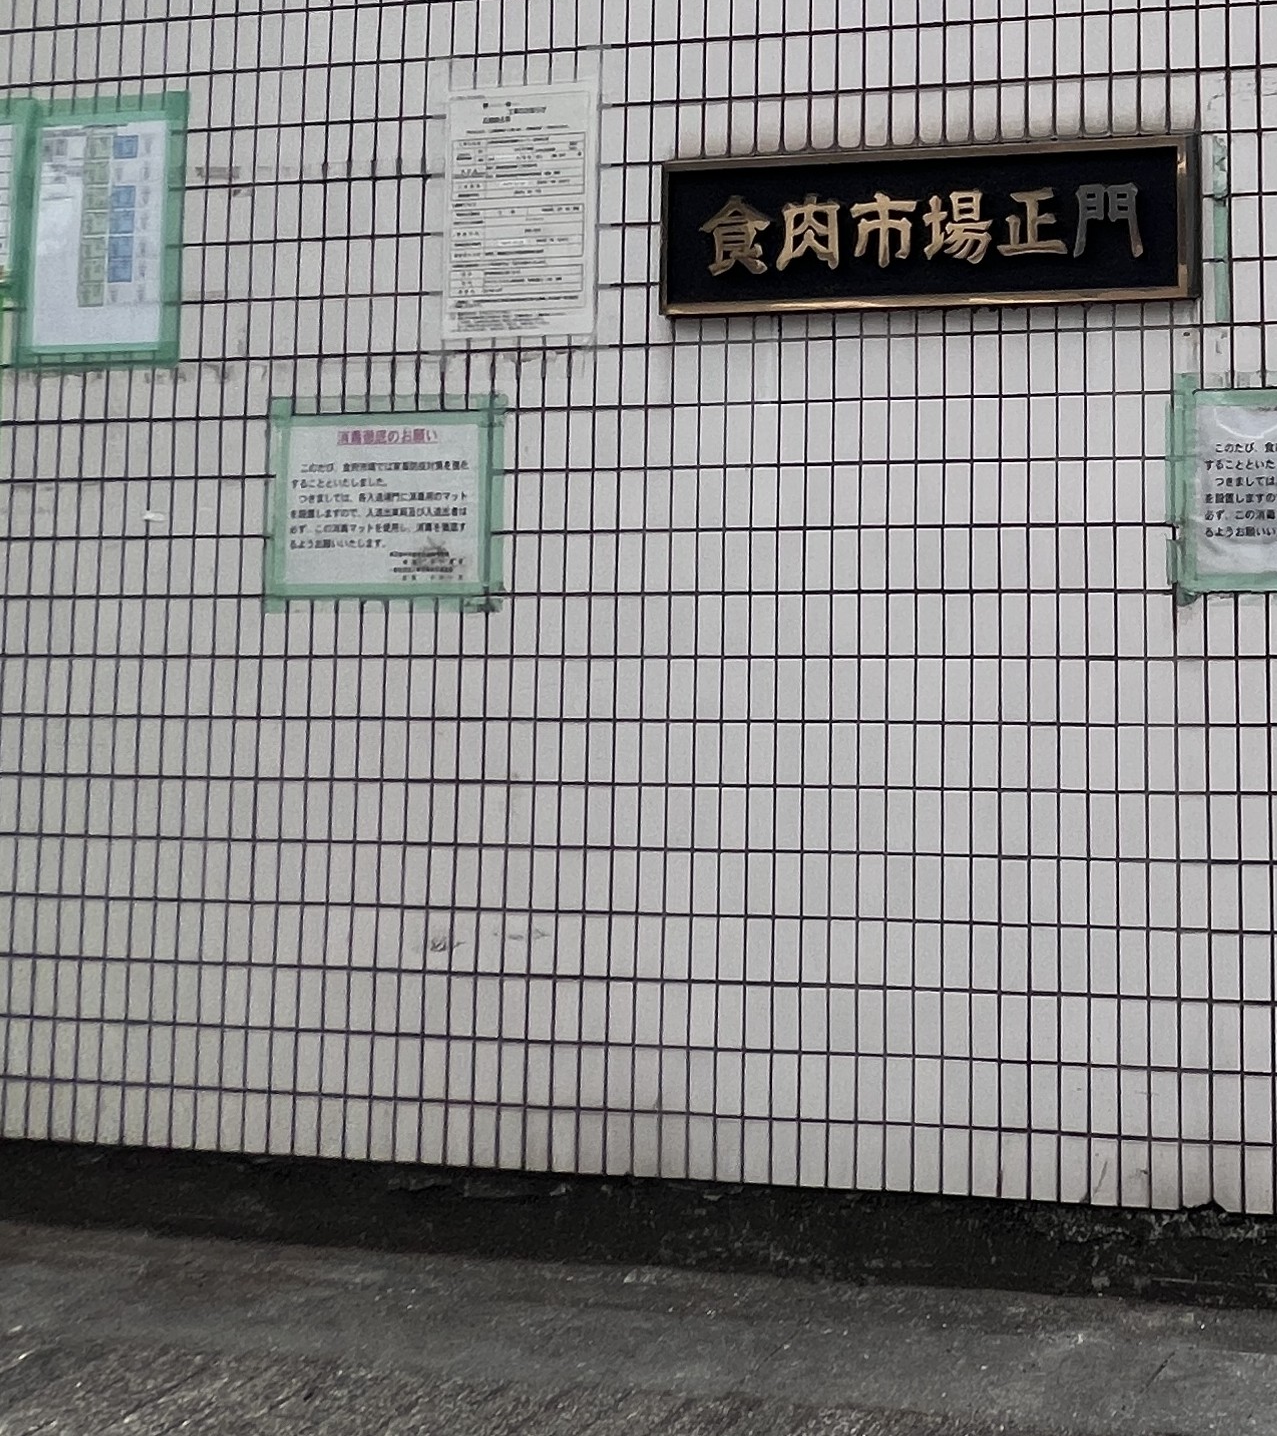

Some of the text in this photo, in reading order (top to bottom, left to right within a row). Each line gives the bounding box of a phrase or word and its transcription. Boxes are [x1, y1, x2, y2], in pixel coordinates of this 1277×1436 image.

[699, 182, 1143, 277] 食肉市場正門
